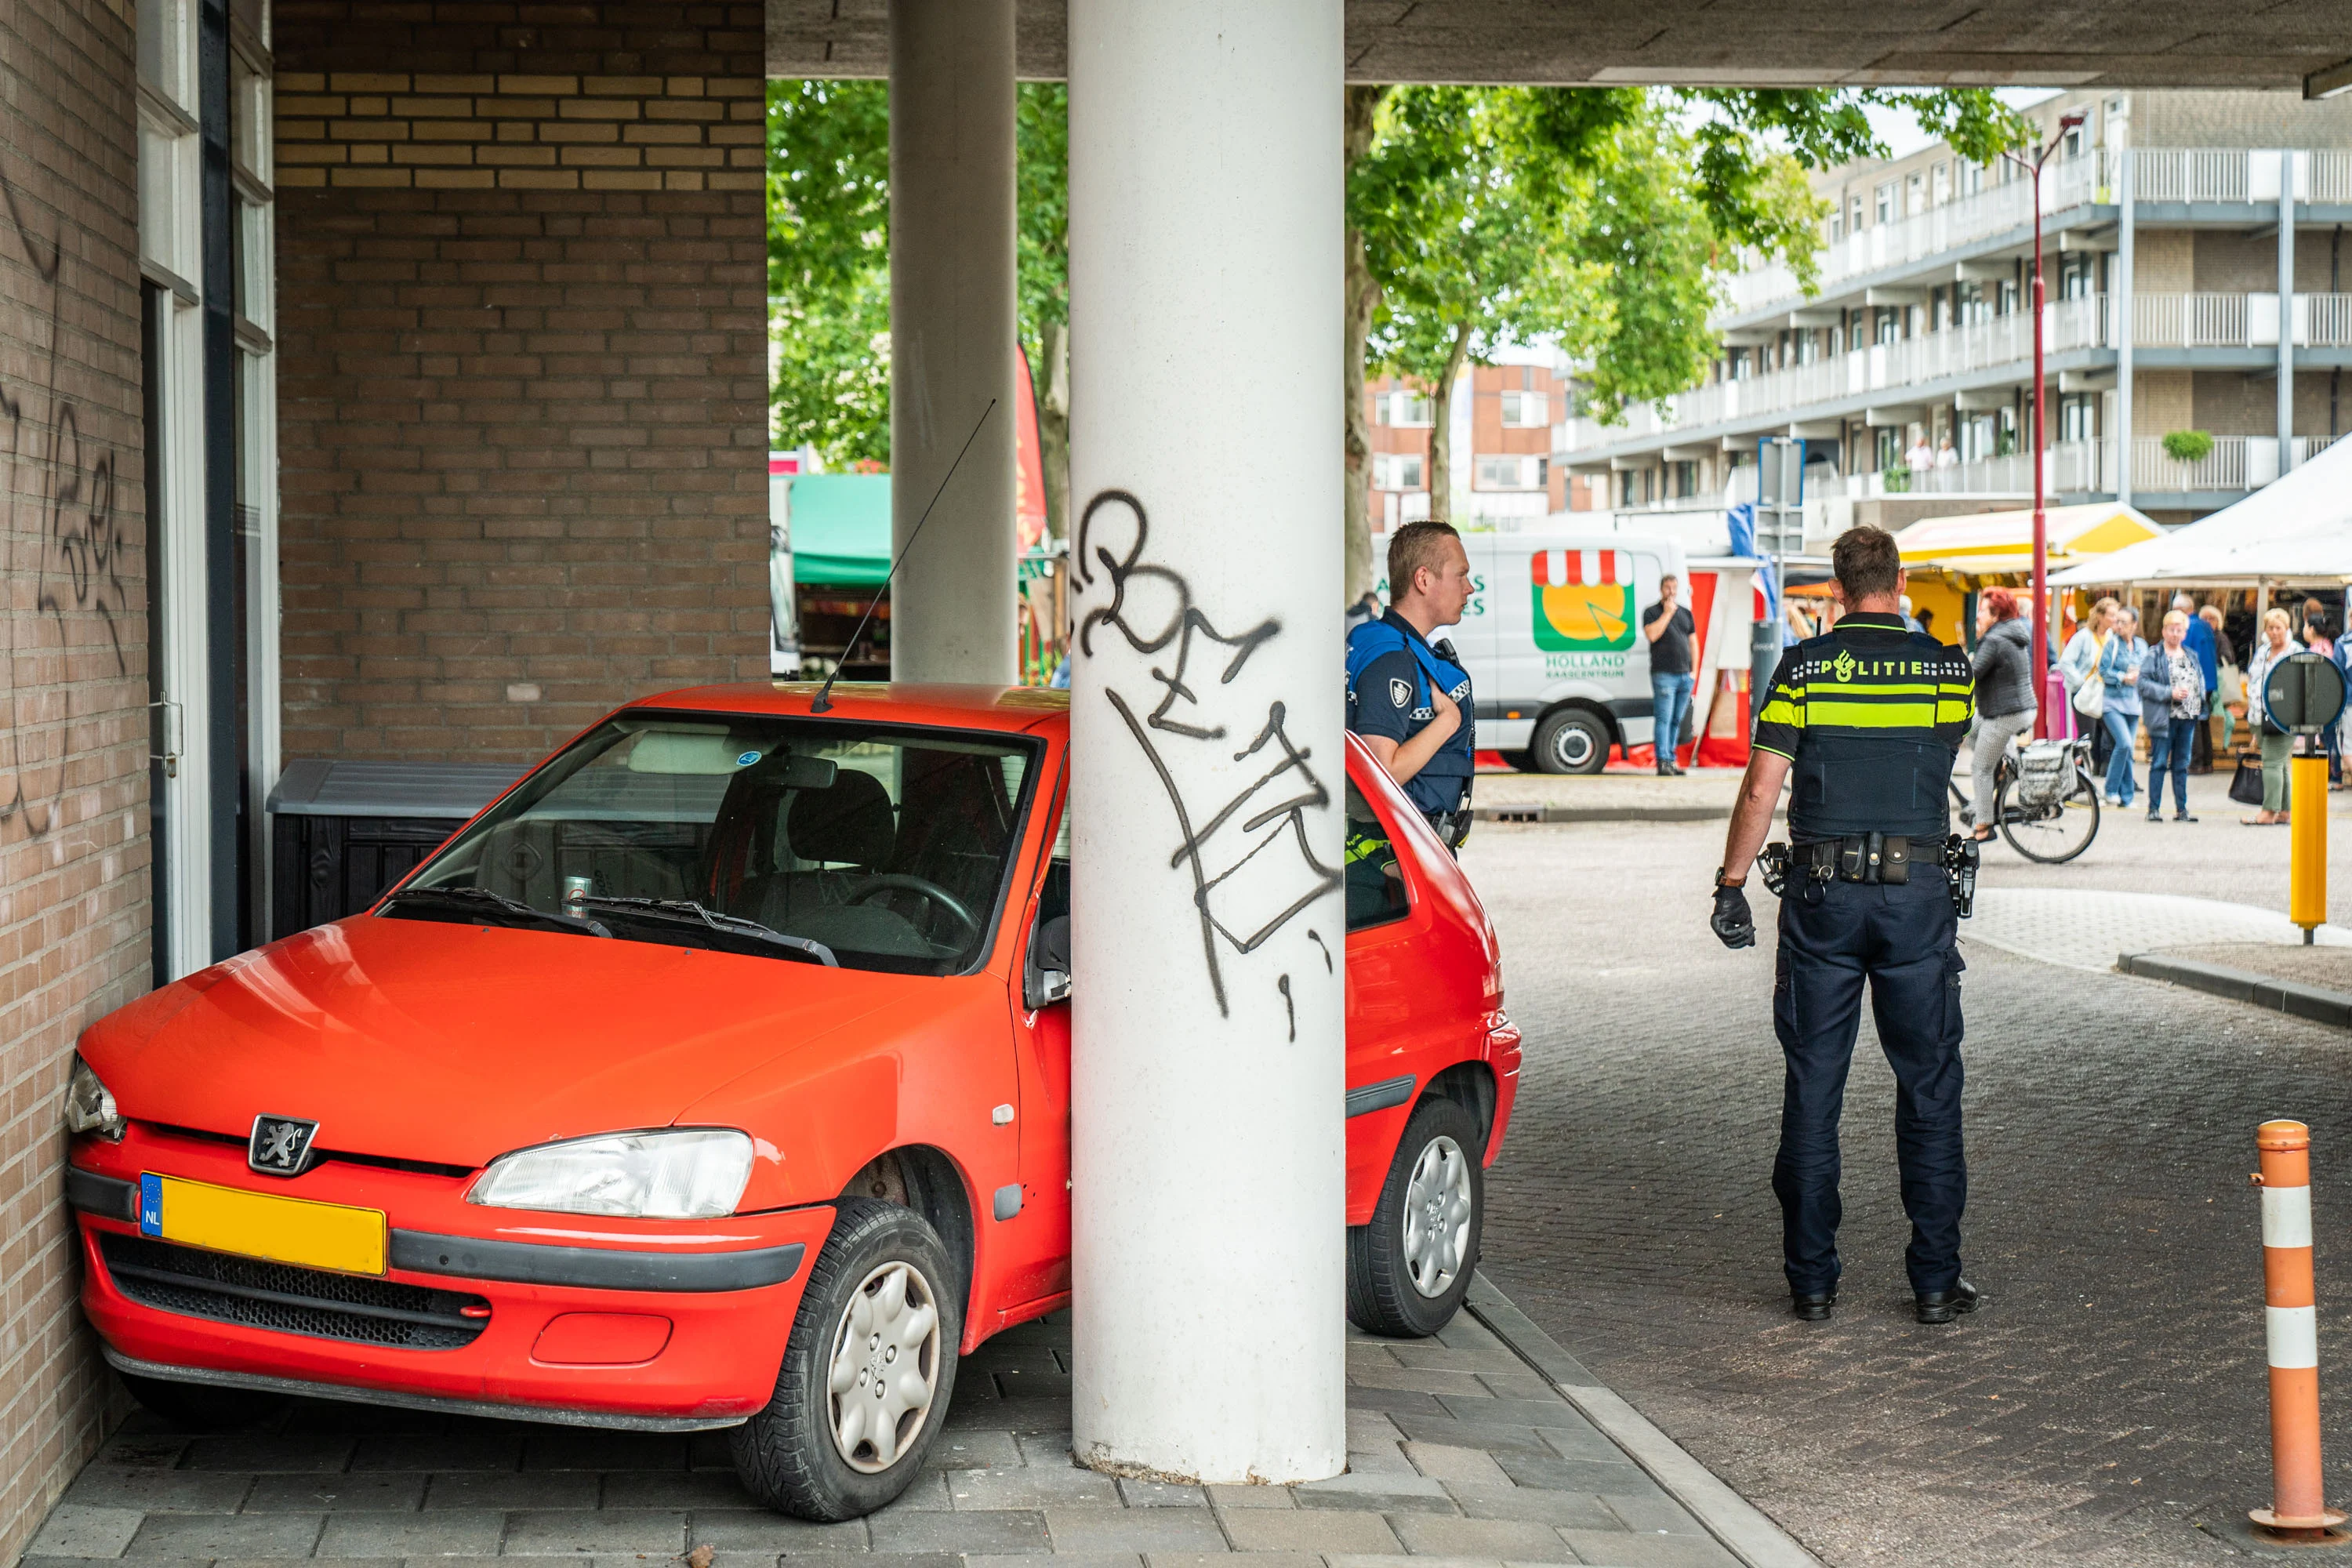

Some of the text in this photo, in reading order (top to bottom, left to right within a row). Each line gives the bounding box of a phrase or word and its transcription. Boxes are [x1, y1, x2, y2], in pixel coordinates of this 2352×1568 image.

[1546, 655, 1624, 668] HOLLAND
[1820, 659, 1923, 682] POLITIE
[145, 1210, 160, 1225] NL
